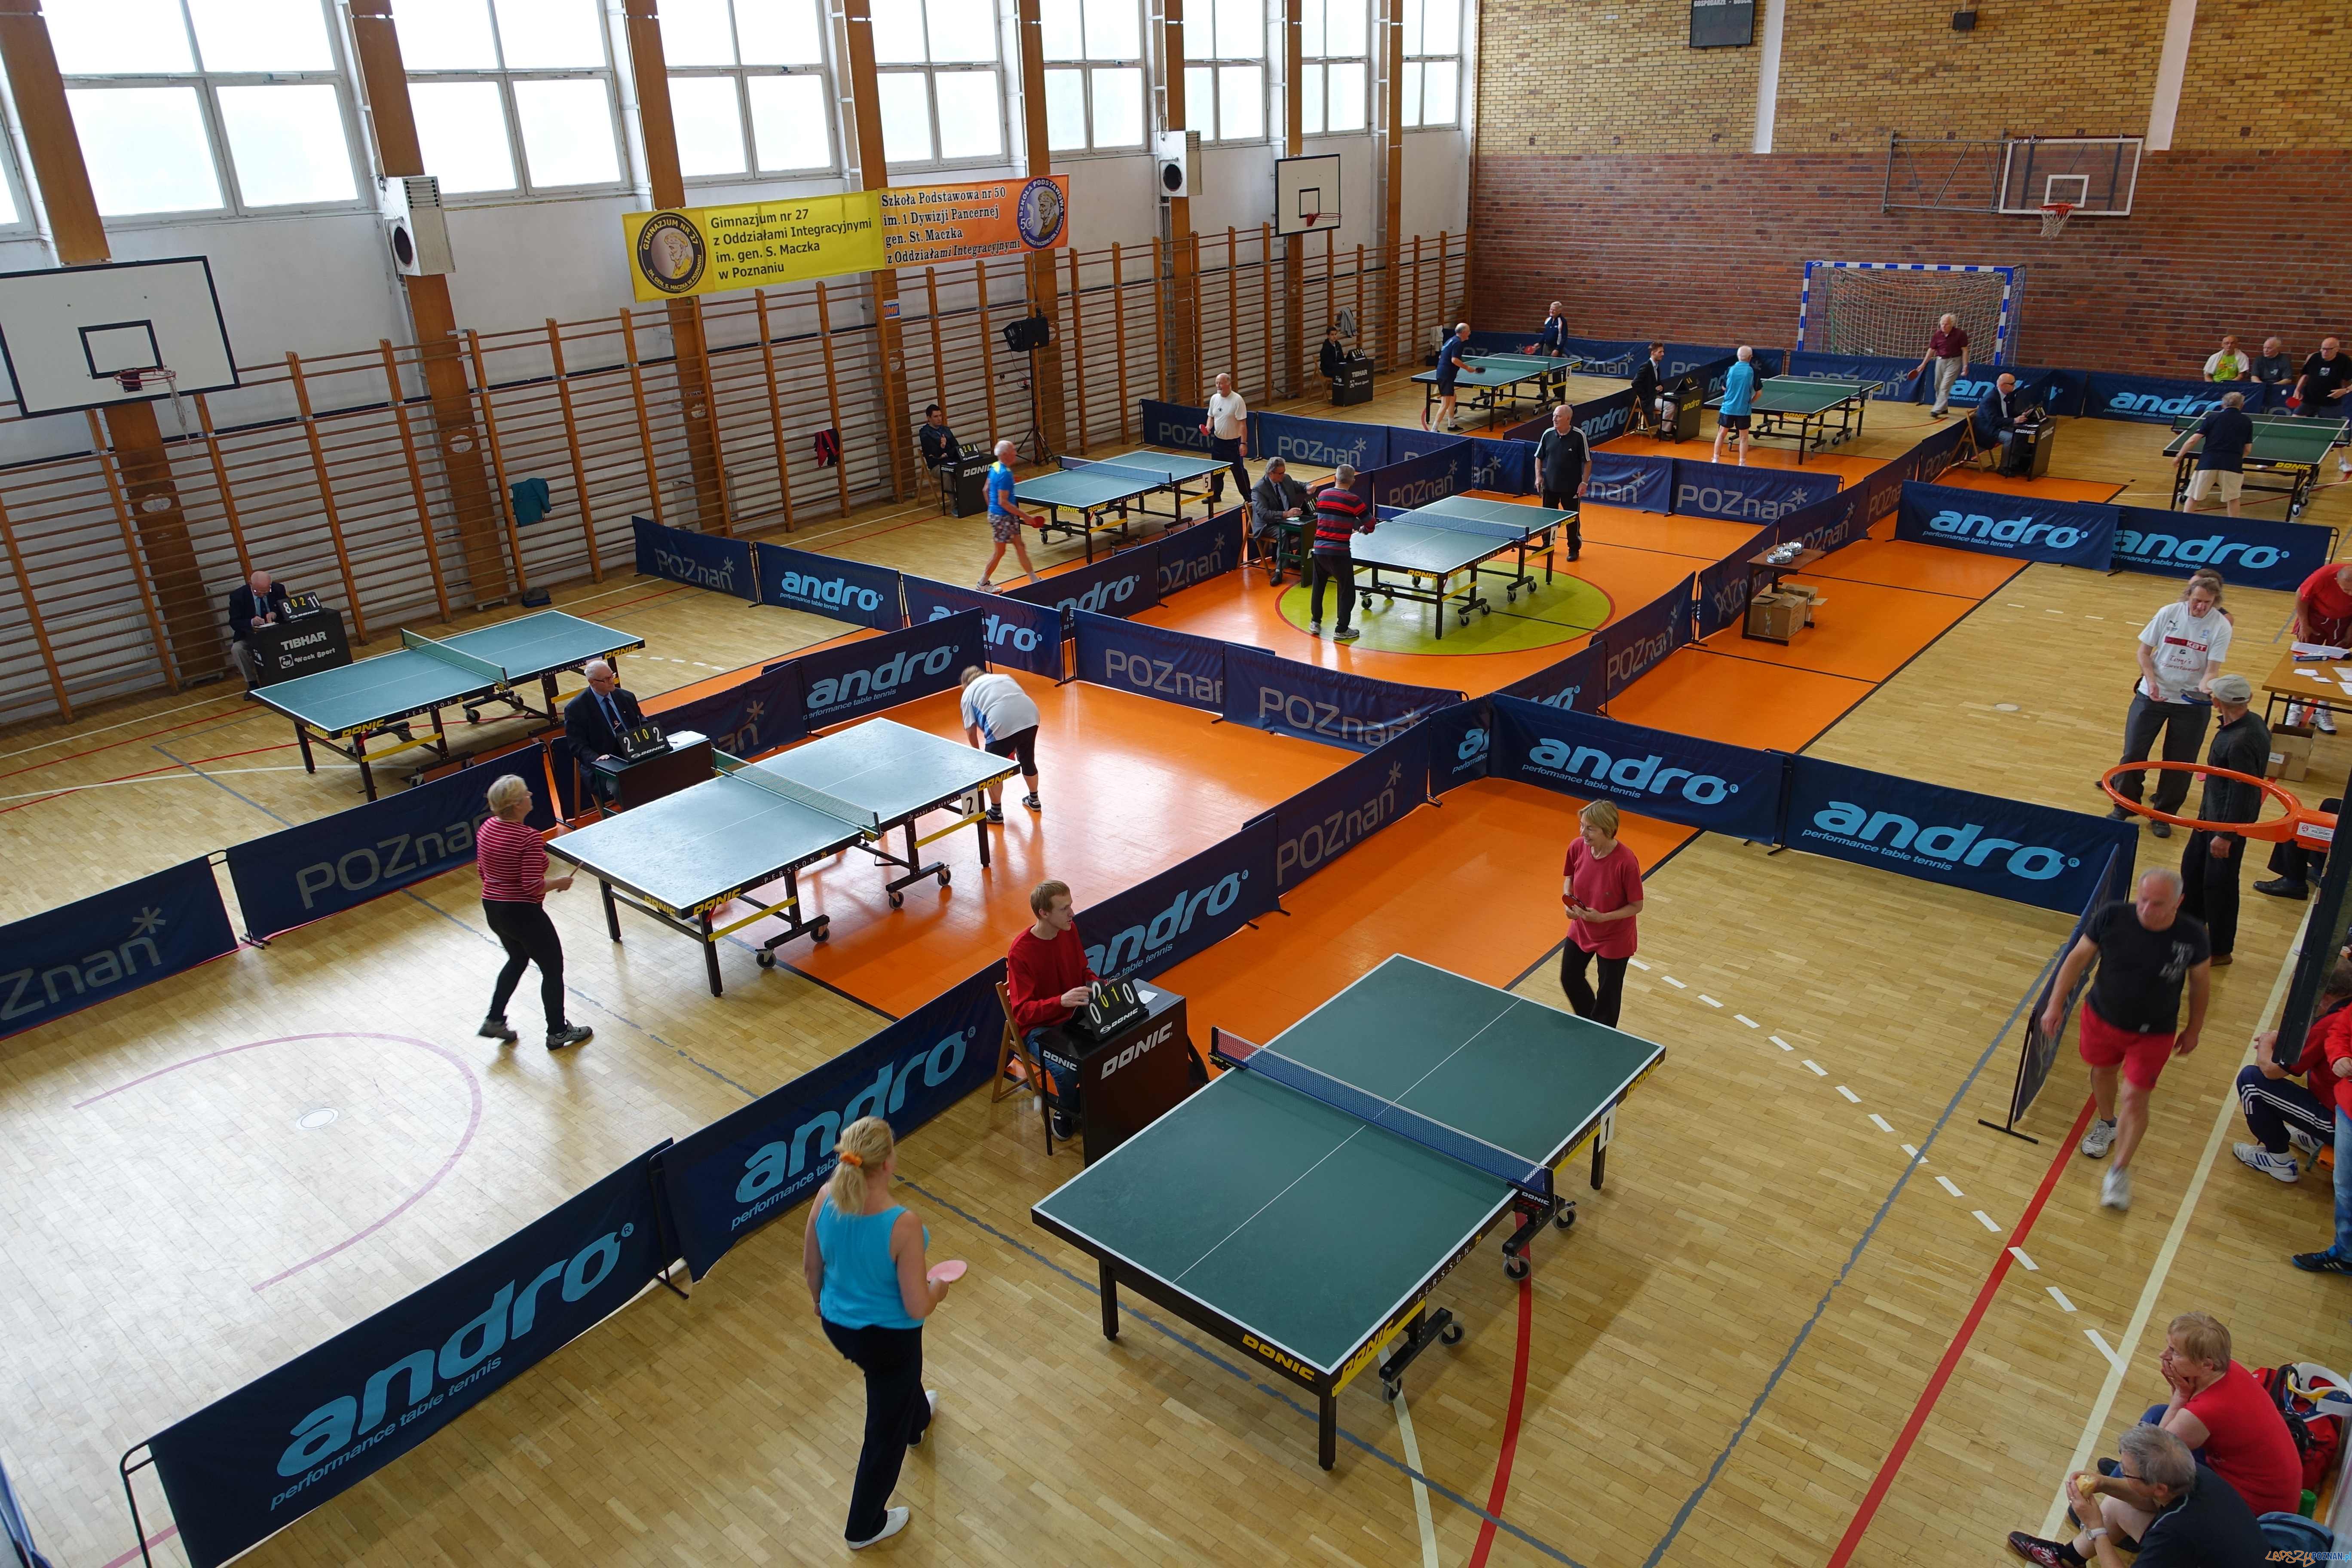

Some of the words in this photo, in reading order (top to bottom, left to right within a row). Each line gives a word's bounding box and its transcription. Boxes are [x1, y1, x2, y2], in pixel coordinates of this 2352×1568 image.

[882, 193, 916, 207] Szkoła
[919, 189, 979, 204] Podstawowa
[982, 189, 991, 199] nr
[994, 186, 1006, 198] 50
[1019, 186, 1032, 217] SZKOŁA
[1033, 179, 1064, 213] PODSTAWOWA
[711, 213, 777, 229] Gimnazjum
[780, 211, 791, 222] nr
[796, 208, 808, 220] 27
[883, 214, 900, 226] im.
[903, 214, 908, 225] 1
[910, 209, 949, 227] Dywizji
[951, 204, 999, 220] Pancernej
[643, 219, 678, 250] GIMNAZJUM
[680, 223, 690, 235] NR
[689, 233, 698, 245] 27
[713, 237, 720, 246] z
[723, 227, 787, 245] Oddziałami
[791, 217, 872, 237] Integracyjnymi
[885, 235, 906, 248] gen.
[910, 231, 923, 243] St.
[925, 227, 963, 242] Maczka
[716, 252, 734, 263] im.
[738, 249, 763, 263] gen.
[766, 246, 776, 257] S.
[780, 241, 820, 255] Maczka
[887, 255, 893, 264] z
[895, 246, 952, 263] Oddziałami
[953, 238, 1021, 257] Integracyjnymi
[718, 270, 728, 279] w
[732, 262, 784, 278] Poznaniu
[670, 281, 689, 290] MACZKA
[1683, 399, 1700, 411] andro
[959, 448, 965, 457] 8
[973, 444, 978, 453] 4
[1213, 466, 1231, 475] DONIC
[1204, 477, 1209, 488] 5
[1058, 505, 1079, 513] DONIC
[1088, 502, 1109, 513] DONIC
[1560, 517, 1576, 527] DONIC
[1551, 530, 1556, 542] 4
[1923, 530, 1969, 542] performance
[1971, 537, 1989, 545] table
[1990, 540, 2014, 548] tennis
[1407, 570, 1438, 580] DONIC
[1448, 565, 1467, 578] DONIC
[2152, 558, 2173, 567] table
[2174, 562, 2202, 570] tennis
[283, 602, 291, 614] 8
[291, 599, 297, 607] 0
[300, 597, 306, 606] 2
[307, 595, 320, 607] 11
[780, 592, 810, 603] performance
[811, 599, 823, 608] table
[824, 602, 839, 611] tennis
[280, 631, 327, 650] TIBHAR
[294, 653, 315, 663] Wack
[317, 647, 335, 658] Sport
[604, 644, 639, 660] DONIC
[803, 701, 852, 720] performance
[853, 695, 872, 707] table
[873, 688, 897, 701] tennis
[309, 724, 329, 738] DONIC
[342, 719, 385, 738] DONIC
[624, 736, 634, 753] 2
[634, 731, 640, 743] 1
[642, 729, 649, 740] 0
[653, 726, 664, 742] 2
[640, 744, 665, 755] DONIC
[978, 769, 1014, 792] DONIC
[1522, 763, 1583, 784] performance
[1584, 778, 1608, 791] table
[1610, 785, 1641, 799] tennis
[938, 796, 960, 808] GERMANY
[966, 796, 974, 815] 2
[1801, 828, 1880, 853] performance
[1881, 847, 1911, 861] table
[1913, 855, 1953, 871] tennis
[645, 895, 677, 916] DONIC
[693, 888, 742, 916] DONIC
[1121, 958, 1144, 977] table
[1145, 943, 1173, 964] tennis
[1089, 1003, 1102, 1024] 0
[1111, 986, 1120, 1002] 1
[1122, 983, 1134, 1004] 0
[1112, 1008, 1139, 1027] DONIC
[1043, 1049, 1077, 1072] DONIC
[1101, 1022, 1173, 1080] DONIC
[1209, 1054, 1224, 1063] andro
[1628, 1057, 1660, 1096] DONIC
[1604, 1118, 1610, 1142] 1
[1568, 1138, 1581, 1154] MADE
[1582, 1131, 1588, 1139] IN
[731, 1171, 815, 1231] performance
[816, 1154, 840, 1178] tabl
[1522, 1191, 1550, 1206] DONIC
[1242, 1334, 1314, 1381] DONIC
[1341, 1319, 1393, 1381] DONIC
[1475, 1233, 1482, 1245] 25
[270, 1420, 396, 1510] performance
[400, 1392, 444, 1427] table
[448, 1355, 502, 1396] tennis
